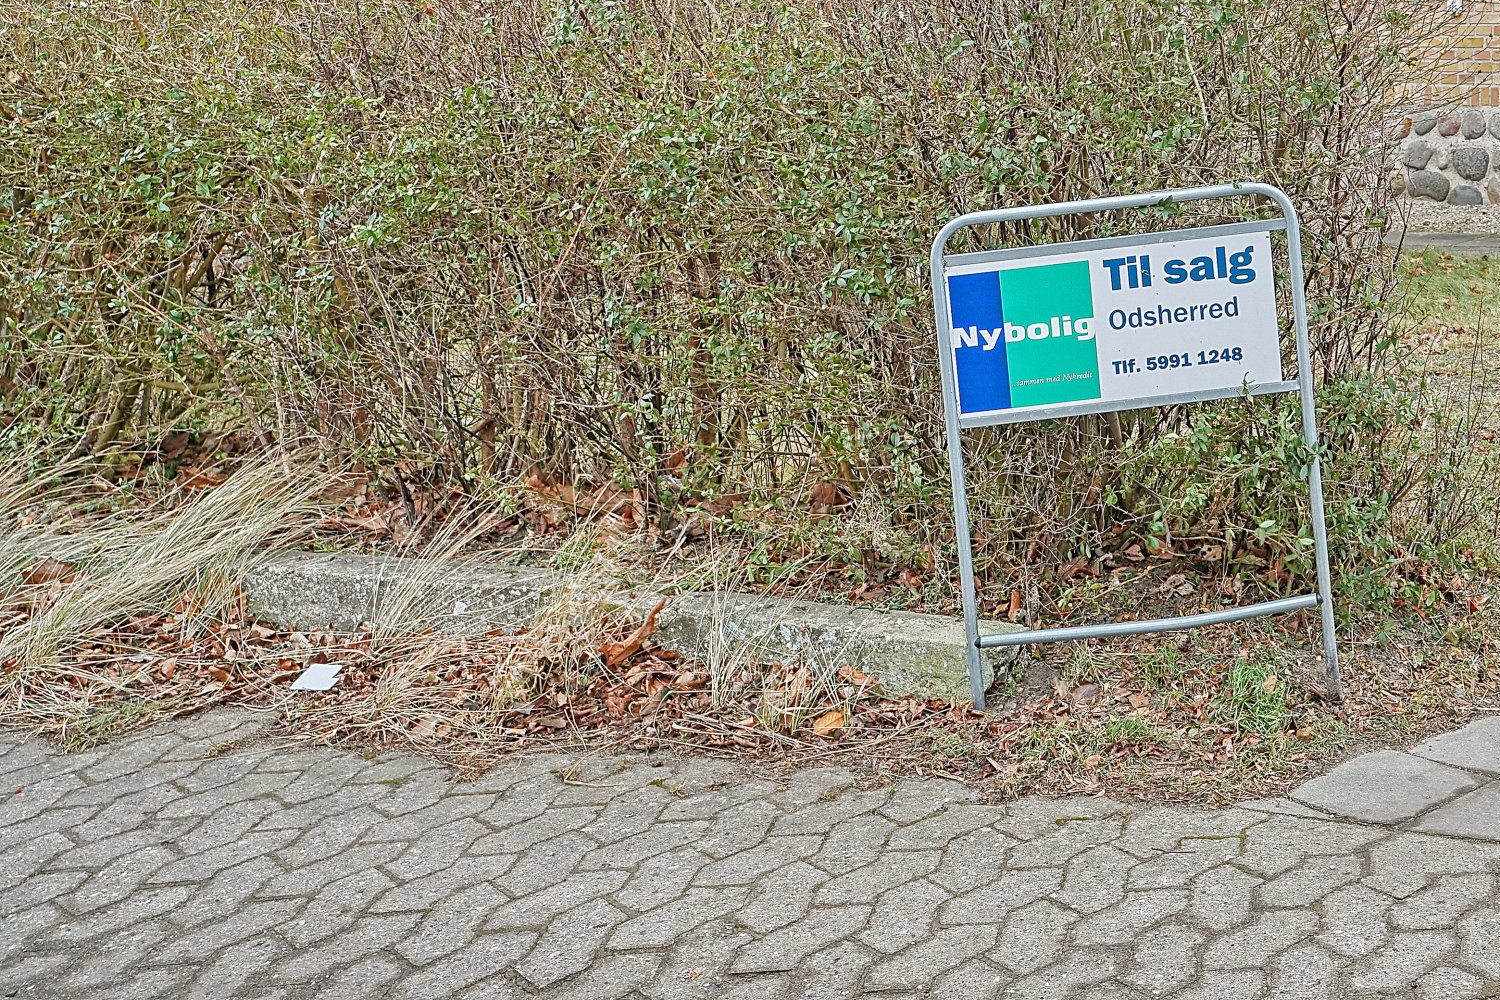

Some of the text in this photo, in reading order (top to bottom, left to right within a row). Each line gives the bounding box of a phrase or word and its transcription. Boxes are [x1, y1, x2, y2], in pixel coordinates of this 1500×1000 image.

[1102, 245, 1256, 291] Til salg
[1108, 295, 1239, 330] Odsherred
[950, 315, 1096, 351] Nybolig
[1112, 346, 1243, 375] Tlf. 5991 1248
